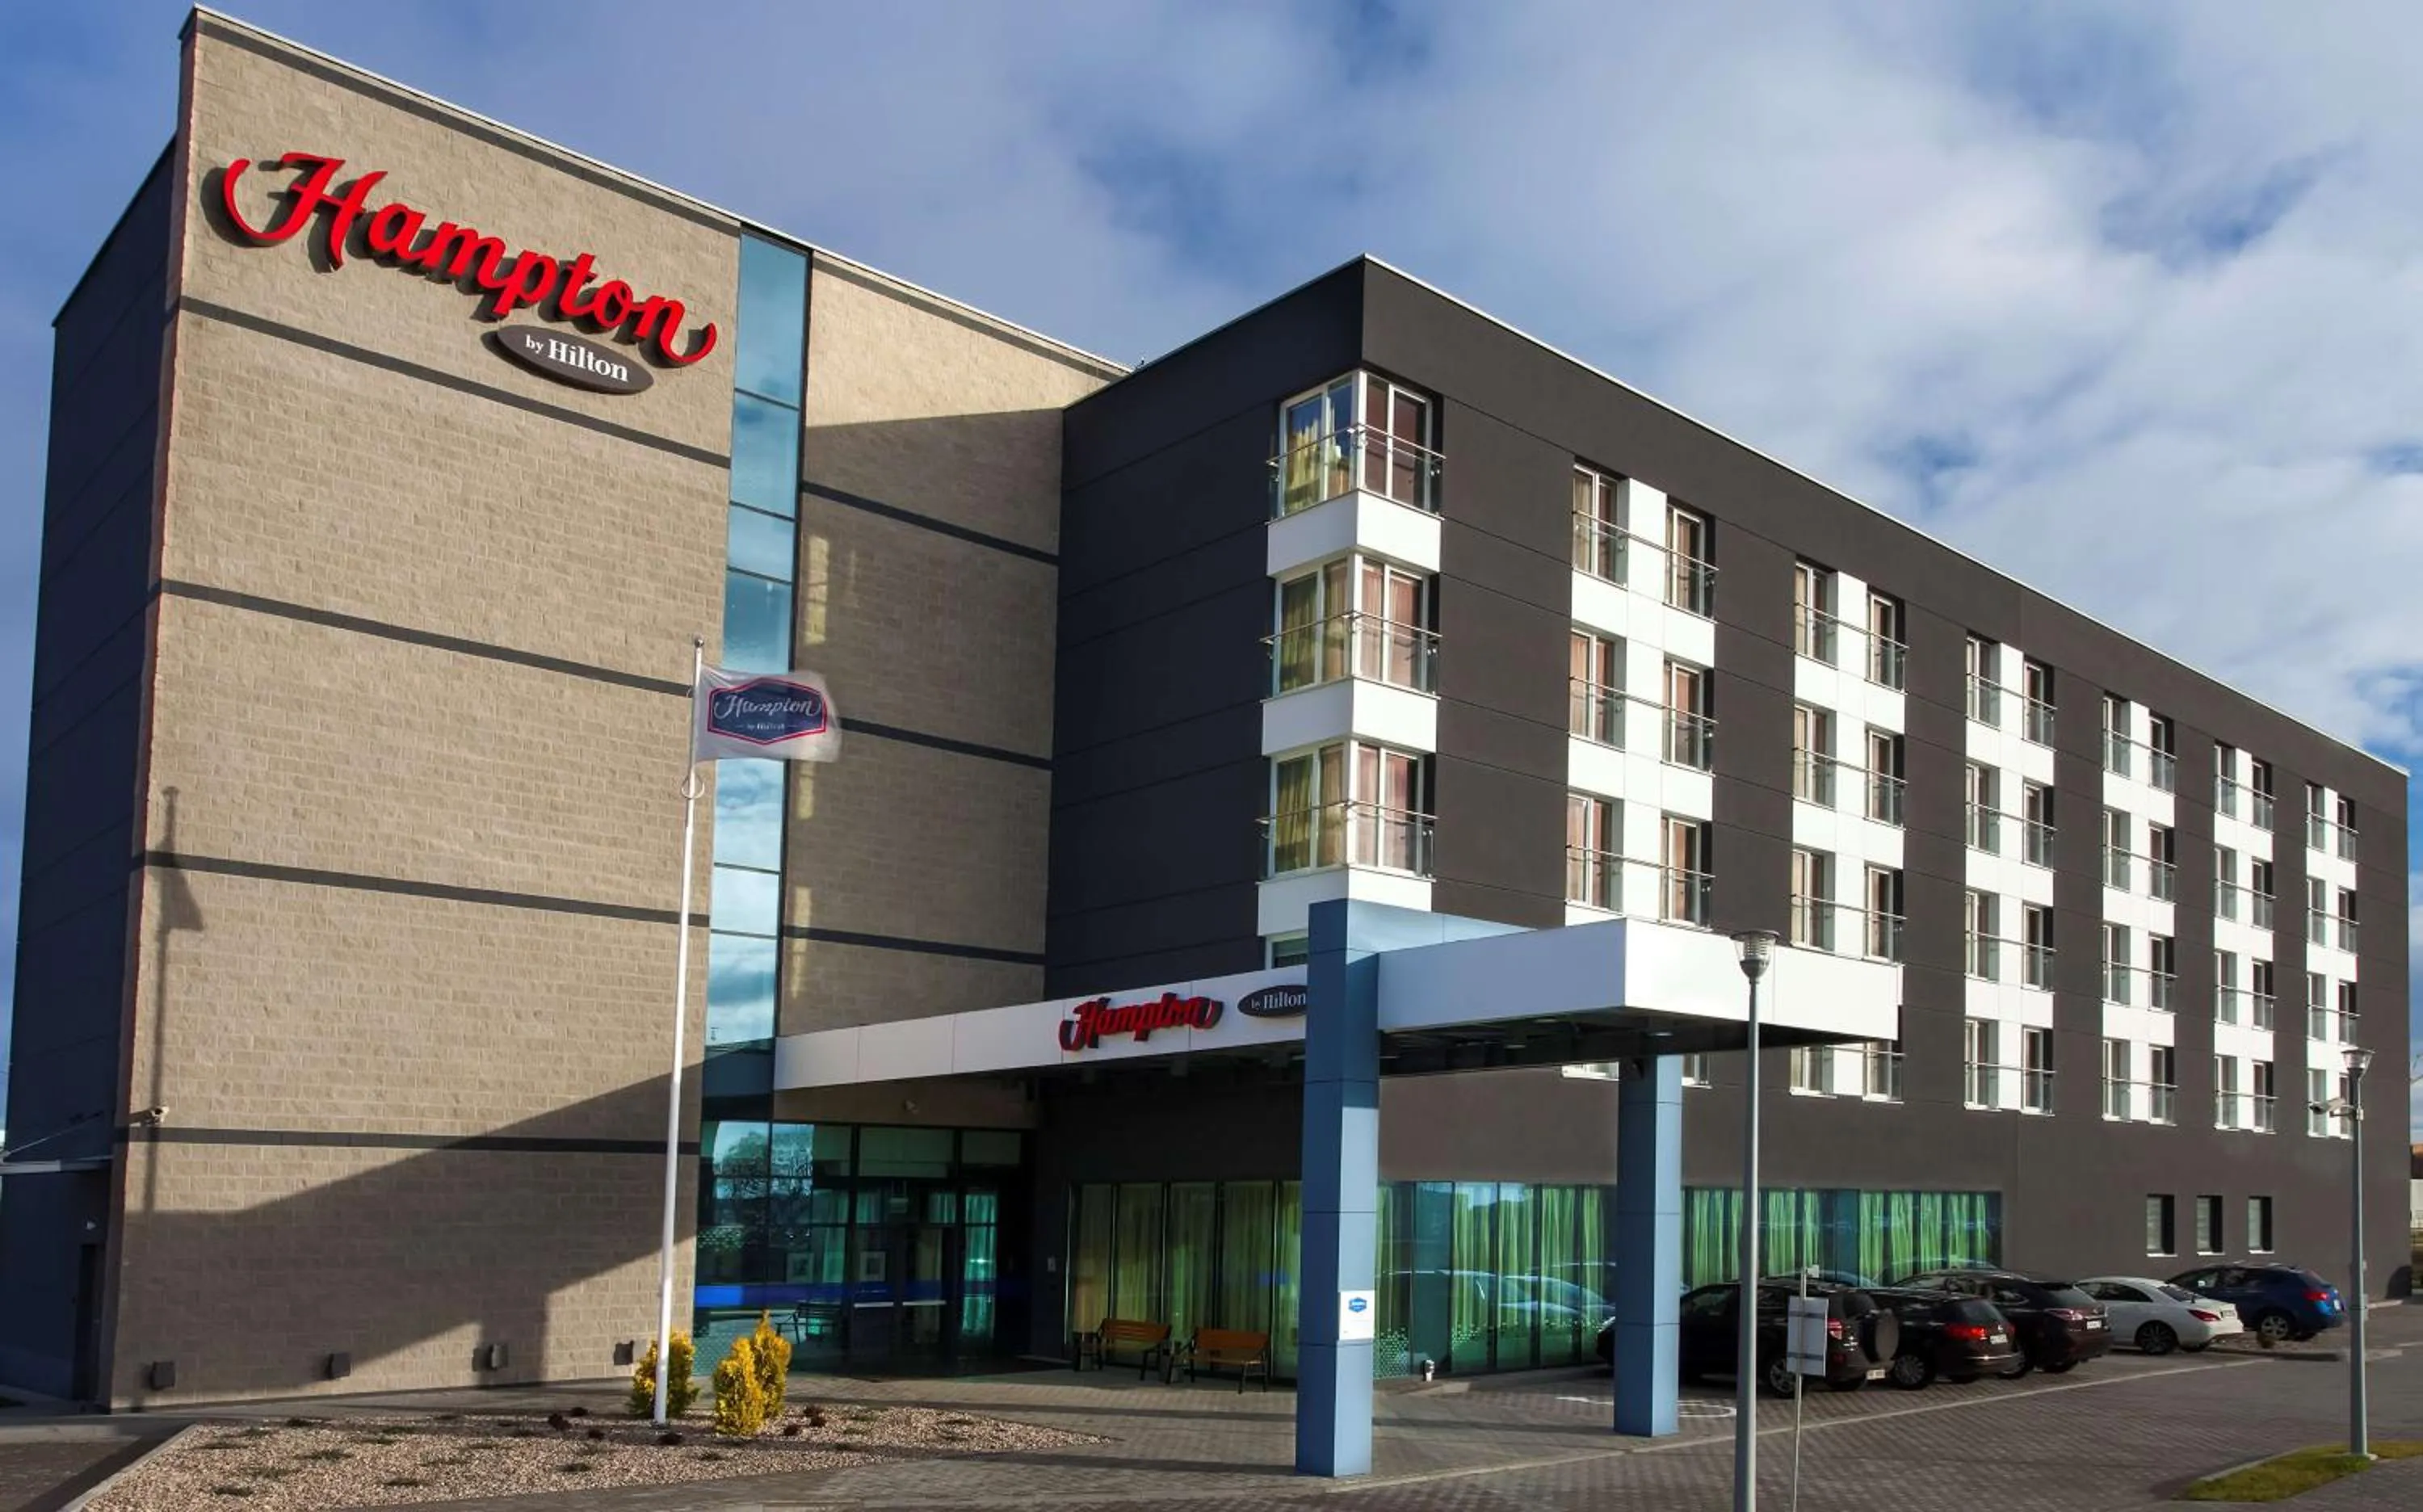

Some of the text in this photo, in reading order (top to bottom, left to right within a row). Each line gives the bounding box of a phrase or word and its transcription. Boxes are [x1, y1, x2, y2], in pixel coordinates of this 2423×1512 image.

[224, 152, 717, 364] Hampton
[525, 334, 628, 383] by Hilton
[714, 694, 821, 720] Hampton
[1058, 991, 1224, 1051] Hampton
[1264, 991, 1306, 1009] Hilton
